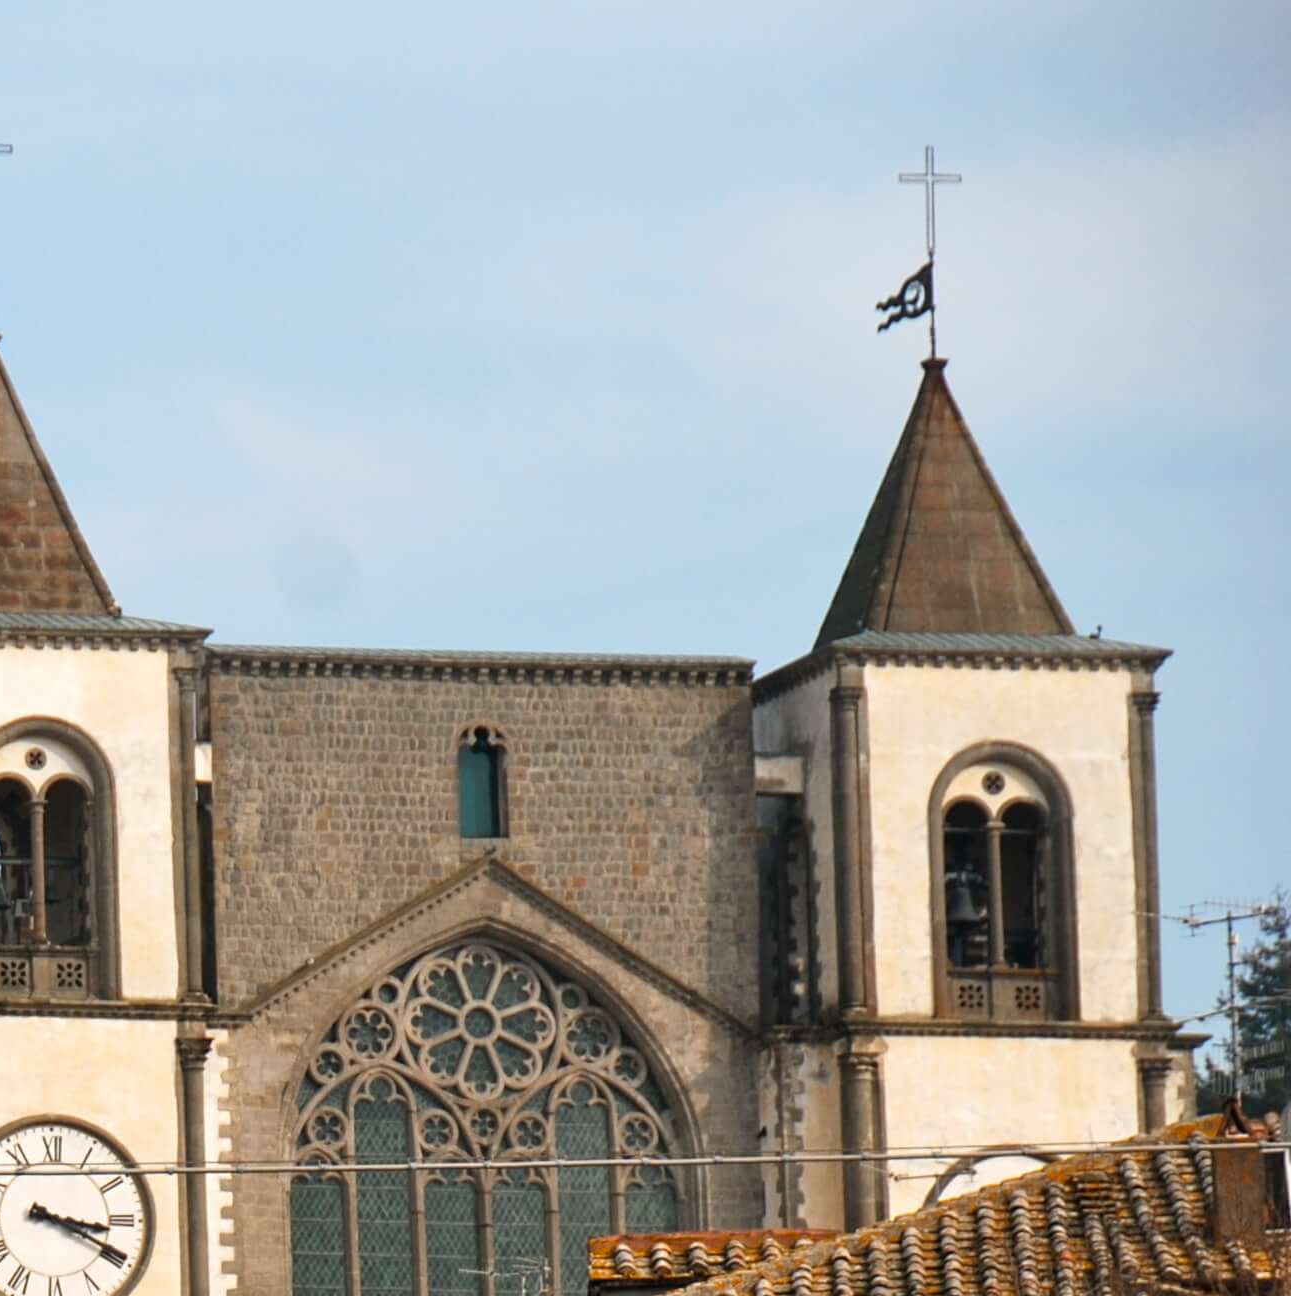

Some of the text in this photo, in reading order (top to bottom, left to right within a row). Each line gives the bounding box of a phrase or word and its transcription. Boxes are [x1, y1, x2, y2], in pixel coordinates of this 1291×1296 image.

[6, 1143, 31, 1169] XI
[42, 1135, 62, 1163] XII
[79, 1147, 93, 1169] I
[99, 1175, 125, 1195] II
[109, 1214, 135, 1227] III
[100, 1246, 127, 1269] III
[8, 1264, 31, 1295] VII
[82, 1270, 101, 1294] V
